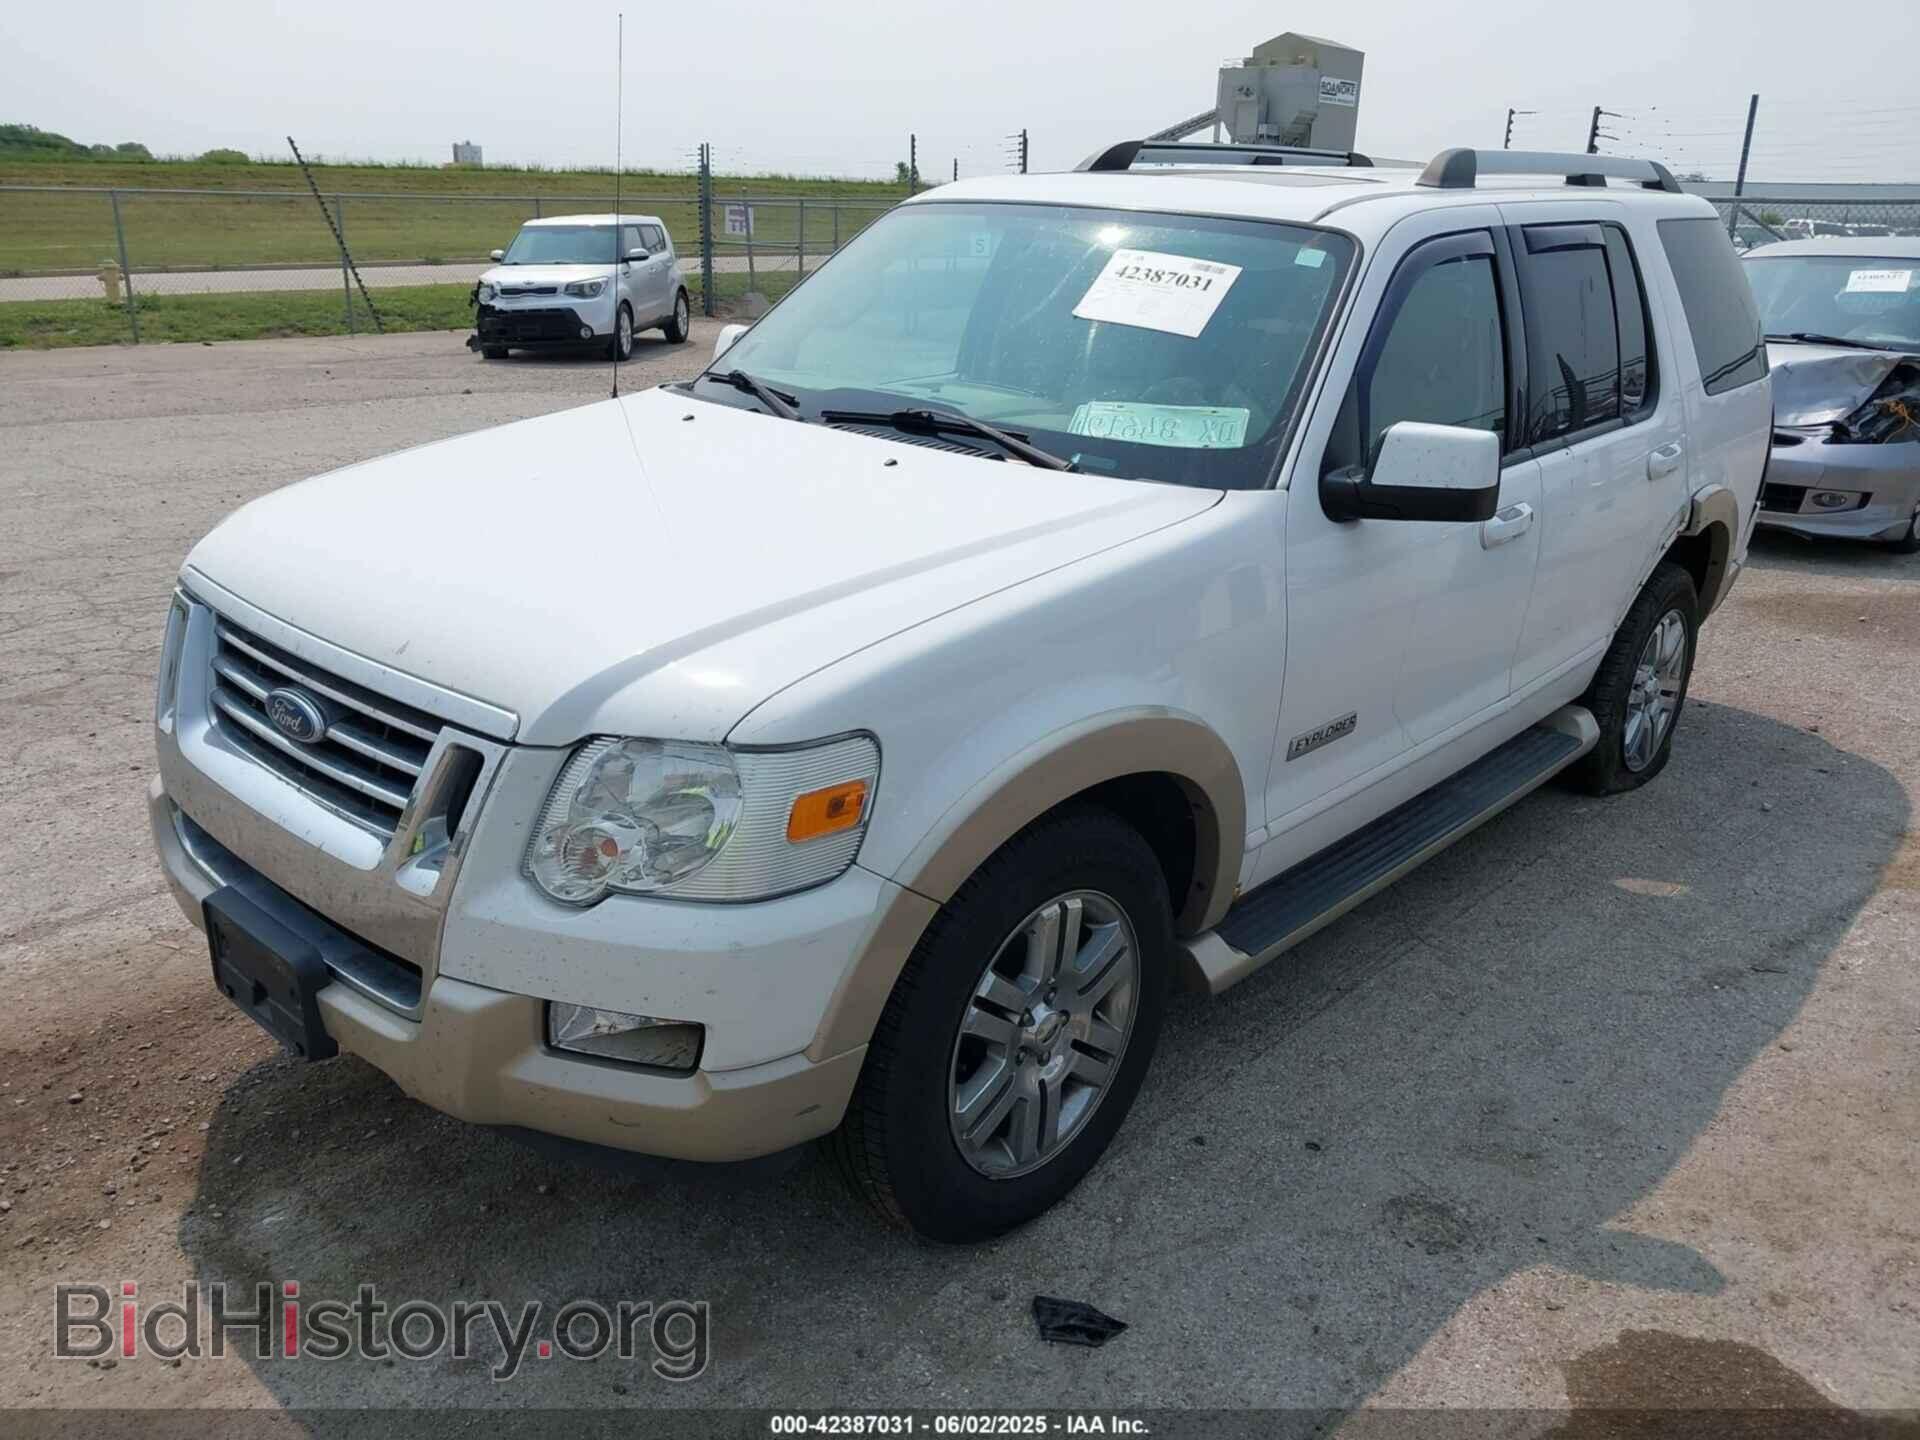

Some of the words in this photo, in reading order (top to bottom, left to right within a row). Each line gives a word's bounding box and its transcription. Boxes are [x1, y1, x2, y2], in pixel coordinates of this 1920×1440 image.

[1115, 265, 1214, 292] 42387031
[272, 698, 302, 732] Ford
[1294, 714, 1357, 752] EXPLORER
